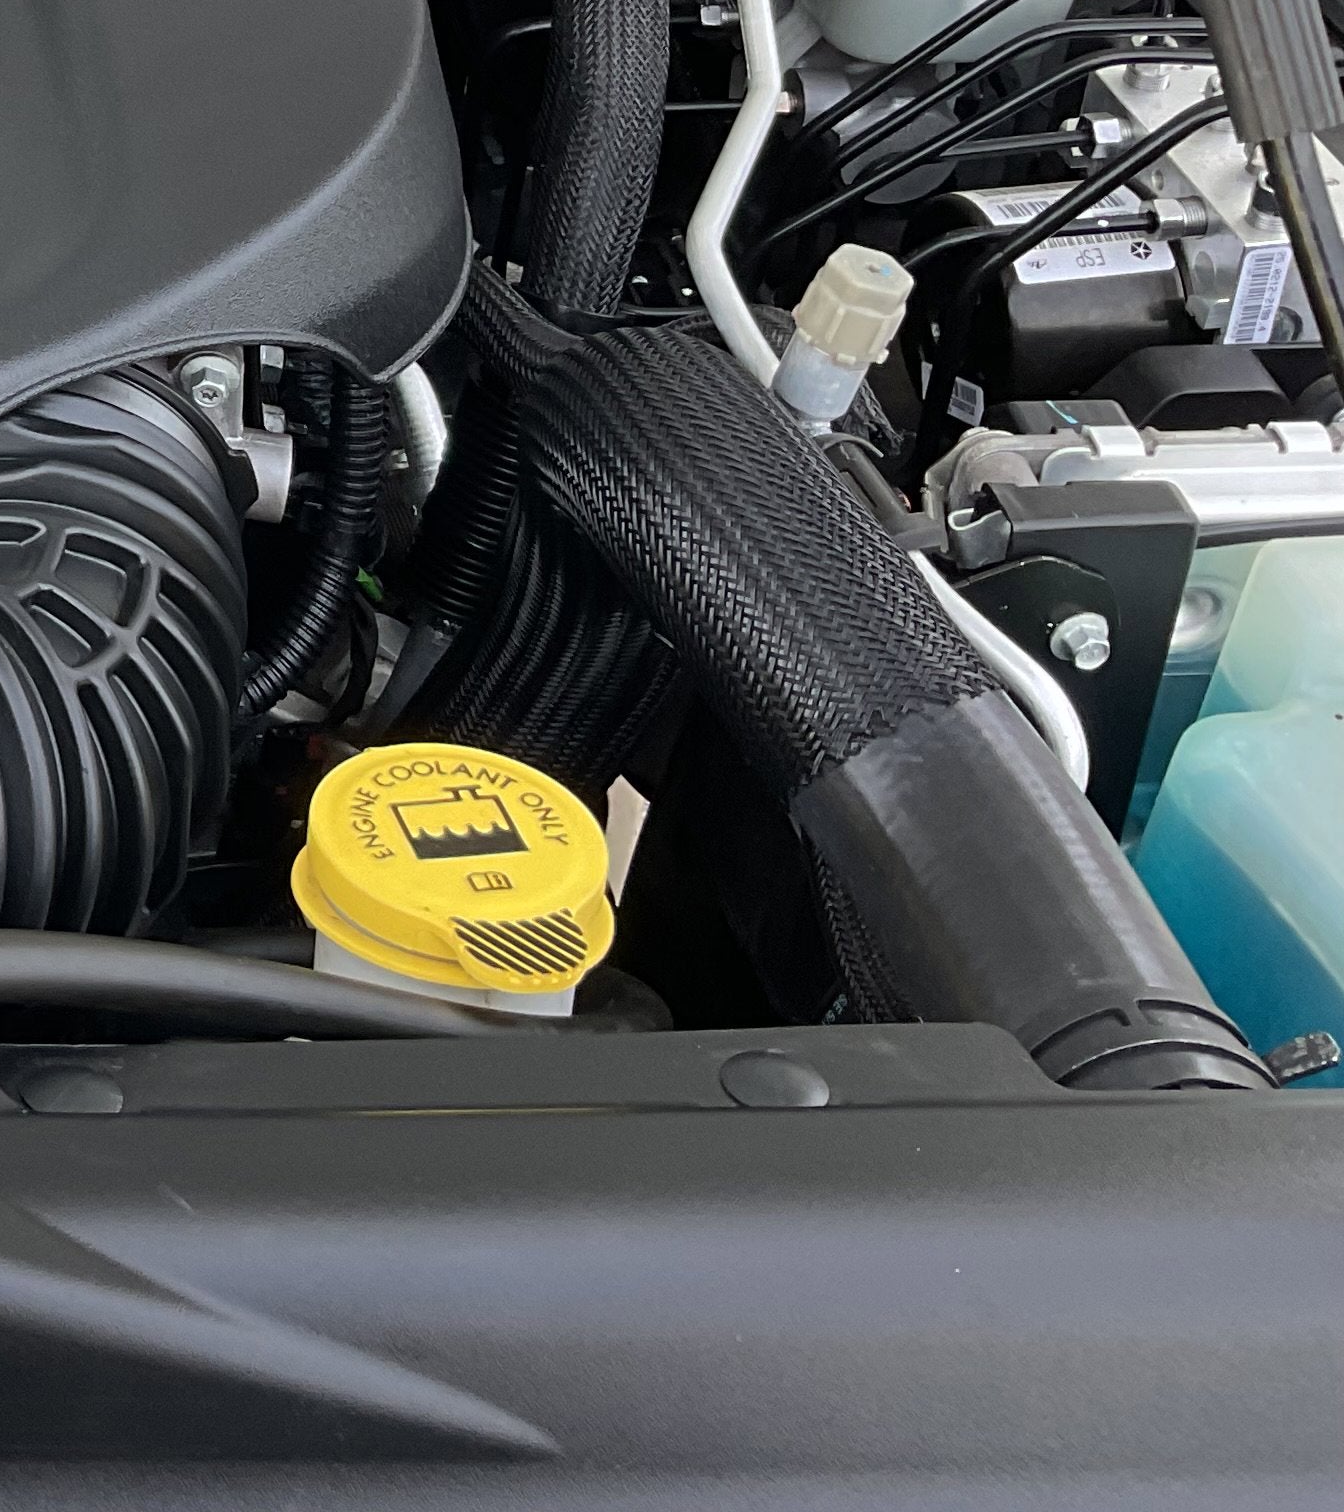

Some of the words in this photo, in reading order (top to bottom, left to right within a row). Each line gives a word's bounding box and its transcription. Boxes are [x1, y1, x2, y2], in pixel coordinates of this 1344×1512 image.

[1076, 247, 1107, 269] ESP
[372, 759, 519, 790] COOLANT
[348, 787, 397, 861] ENGINE
[520, 791, 570, 846] ONLY
